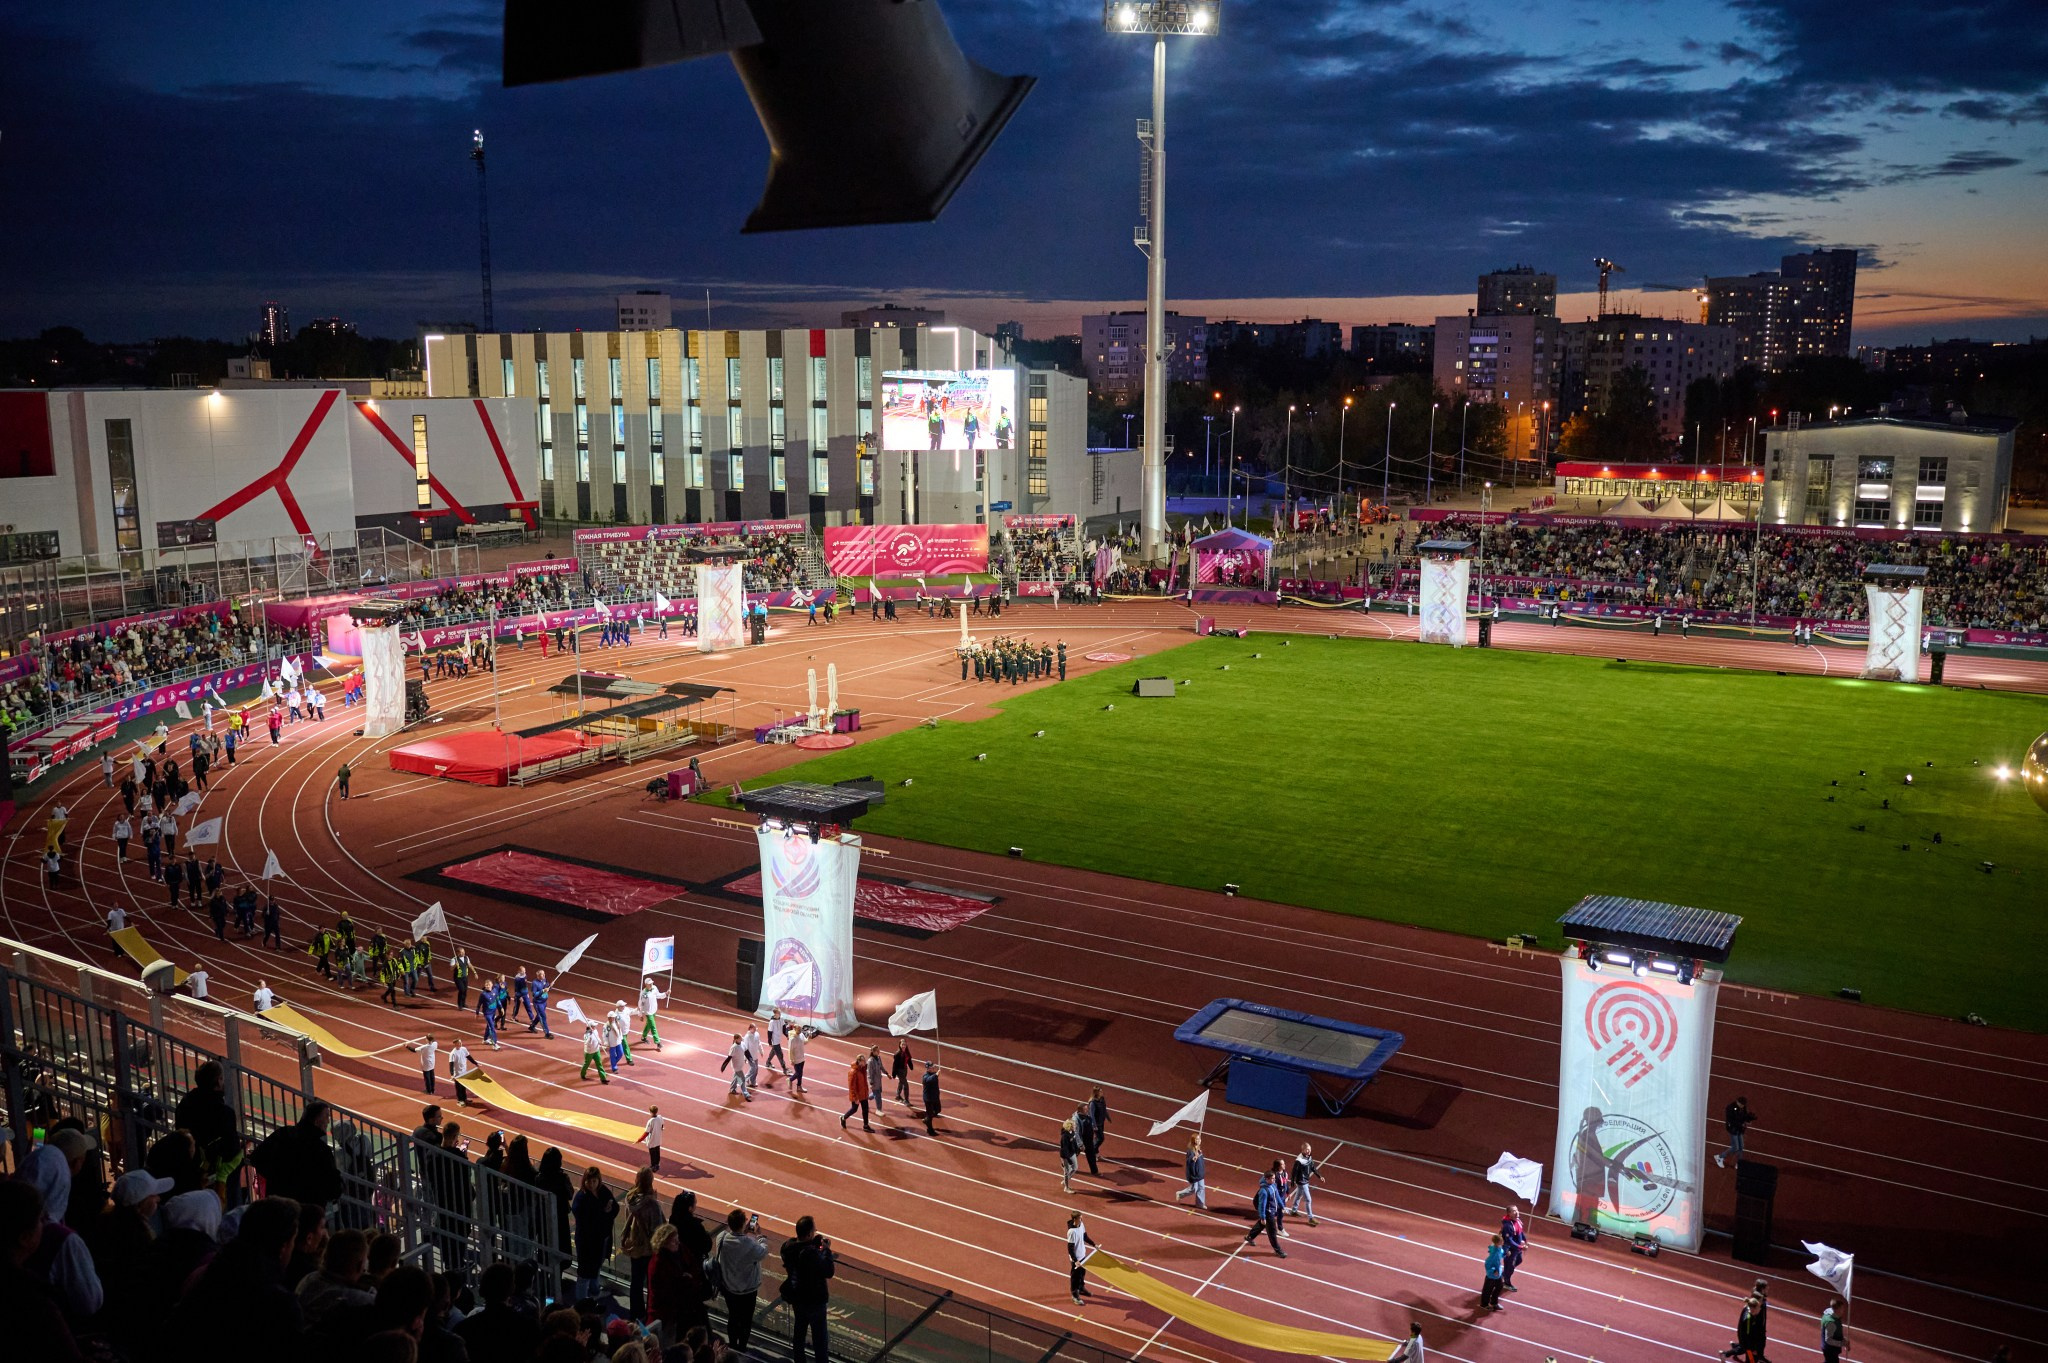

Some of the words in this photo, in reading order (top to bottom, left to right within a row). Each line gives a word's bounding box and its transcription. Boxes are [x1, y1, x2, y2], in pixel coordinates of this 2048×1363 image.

[1553, 517, 1587, 525] ЗАПАДНАЯ
[578, 532, 602, 540] ЮЖНАЯ
[602, 531, 630, 539] ТРИБУНА
[1782, 527, 1821, 535] ЗАПАДНАЯ
[1822, 529, 1856, 537] ТРИБУНА
[517, 565, 540, 574] ЮЖНАЯ
[541, 563, 570, 572] ТРИБУНА
